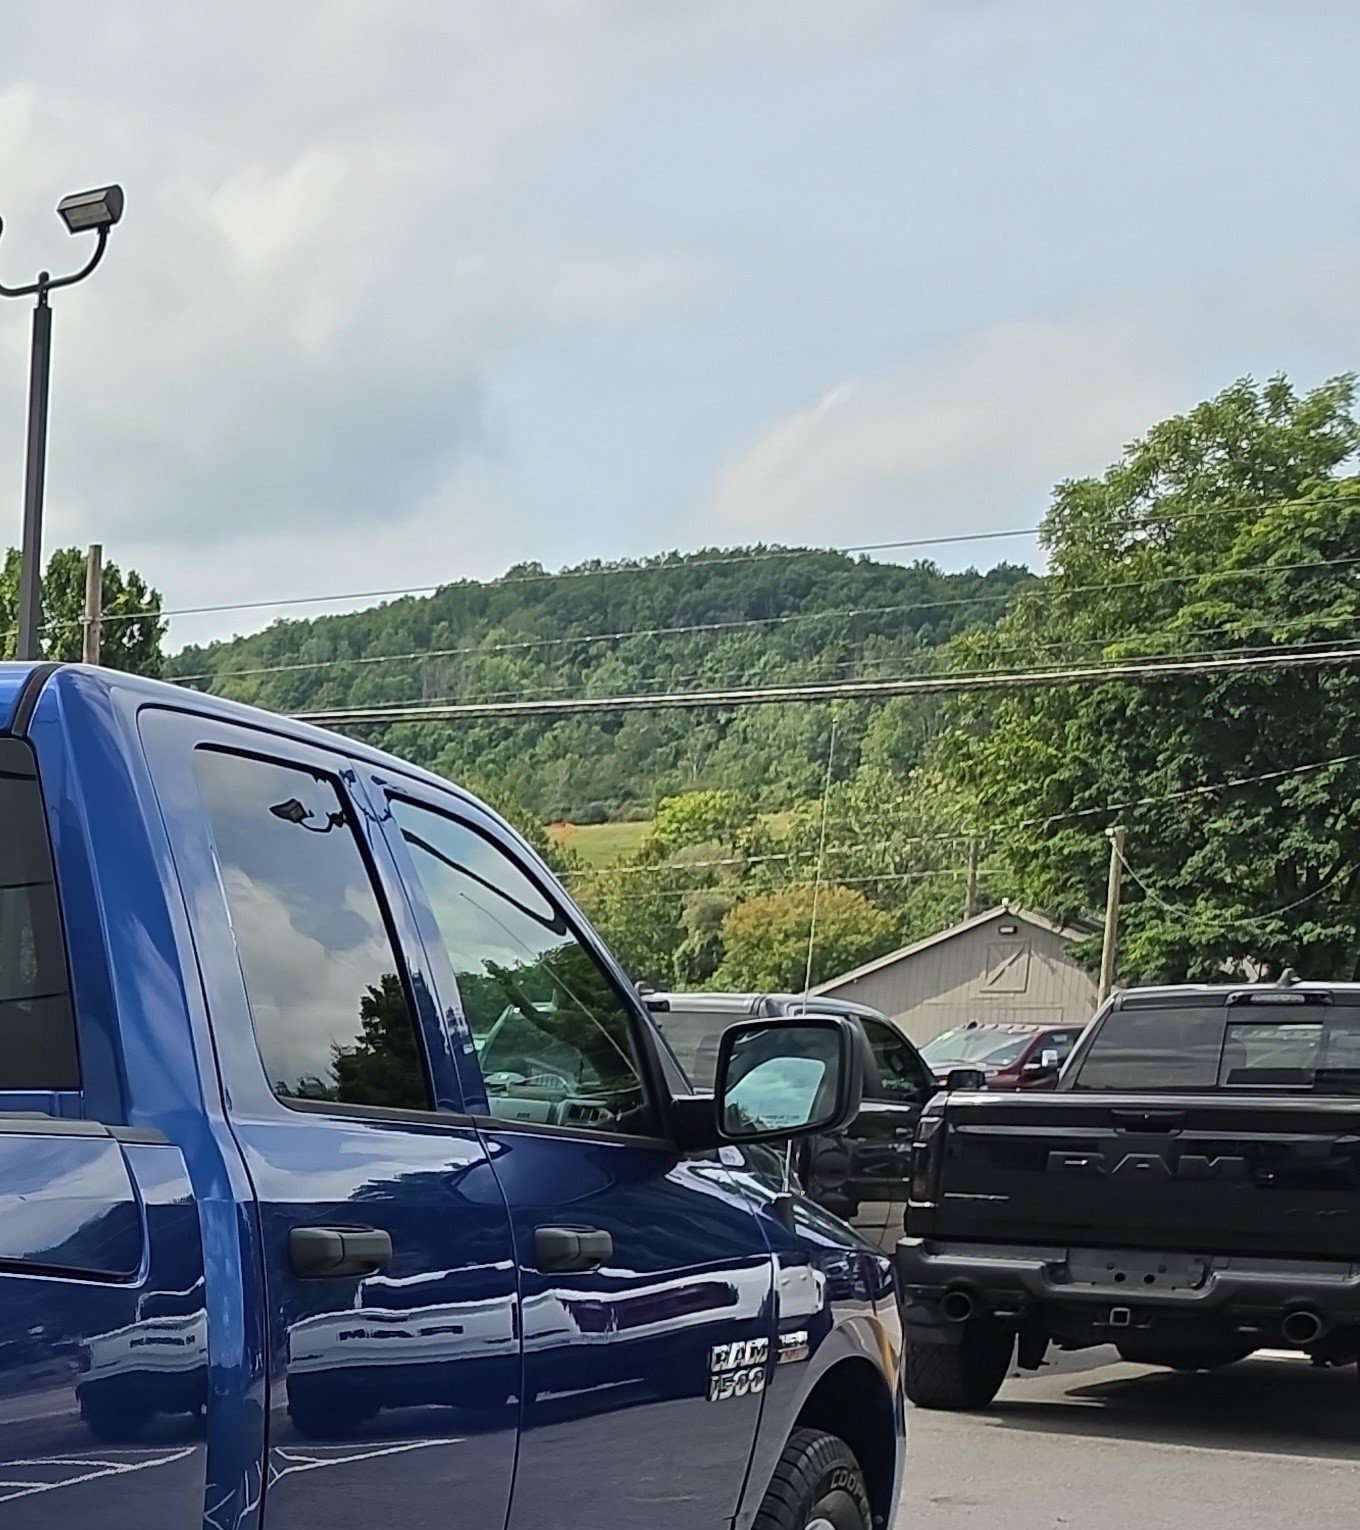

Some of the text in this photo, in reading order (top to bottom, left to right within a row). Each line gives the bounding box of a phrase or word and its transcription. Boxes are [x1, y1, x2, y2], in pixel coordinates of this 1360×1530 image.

[1047, 1150, 1246, 1177] RAM
[711, 1337, 769, 1373] RAM
[710, 1366, 766, 1402] 1500
